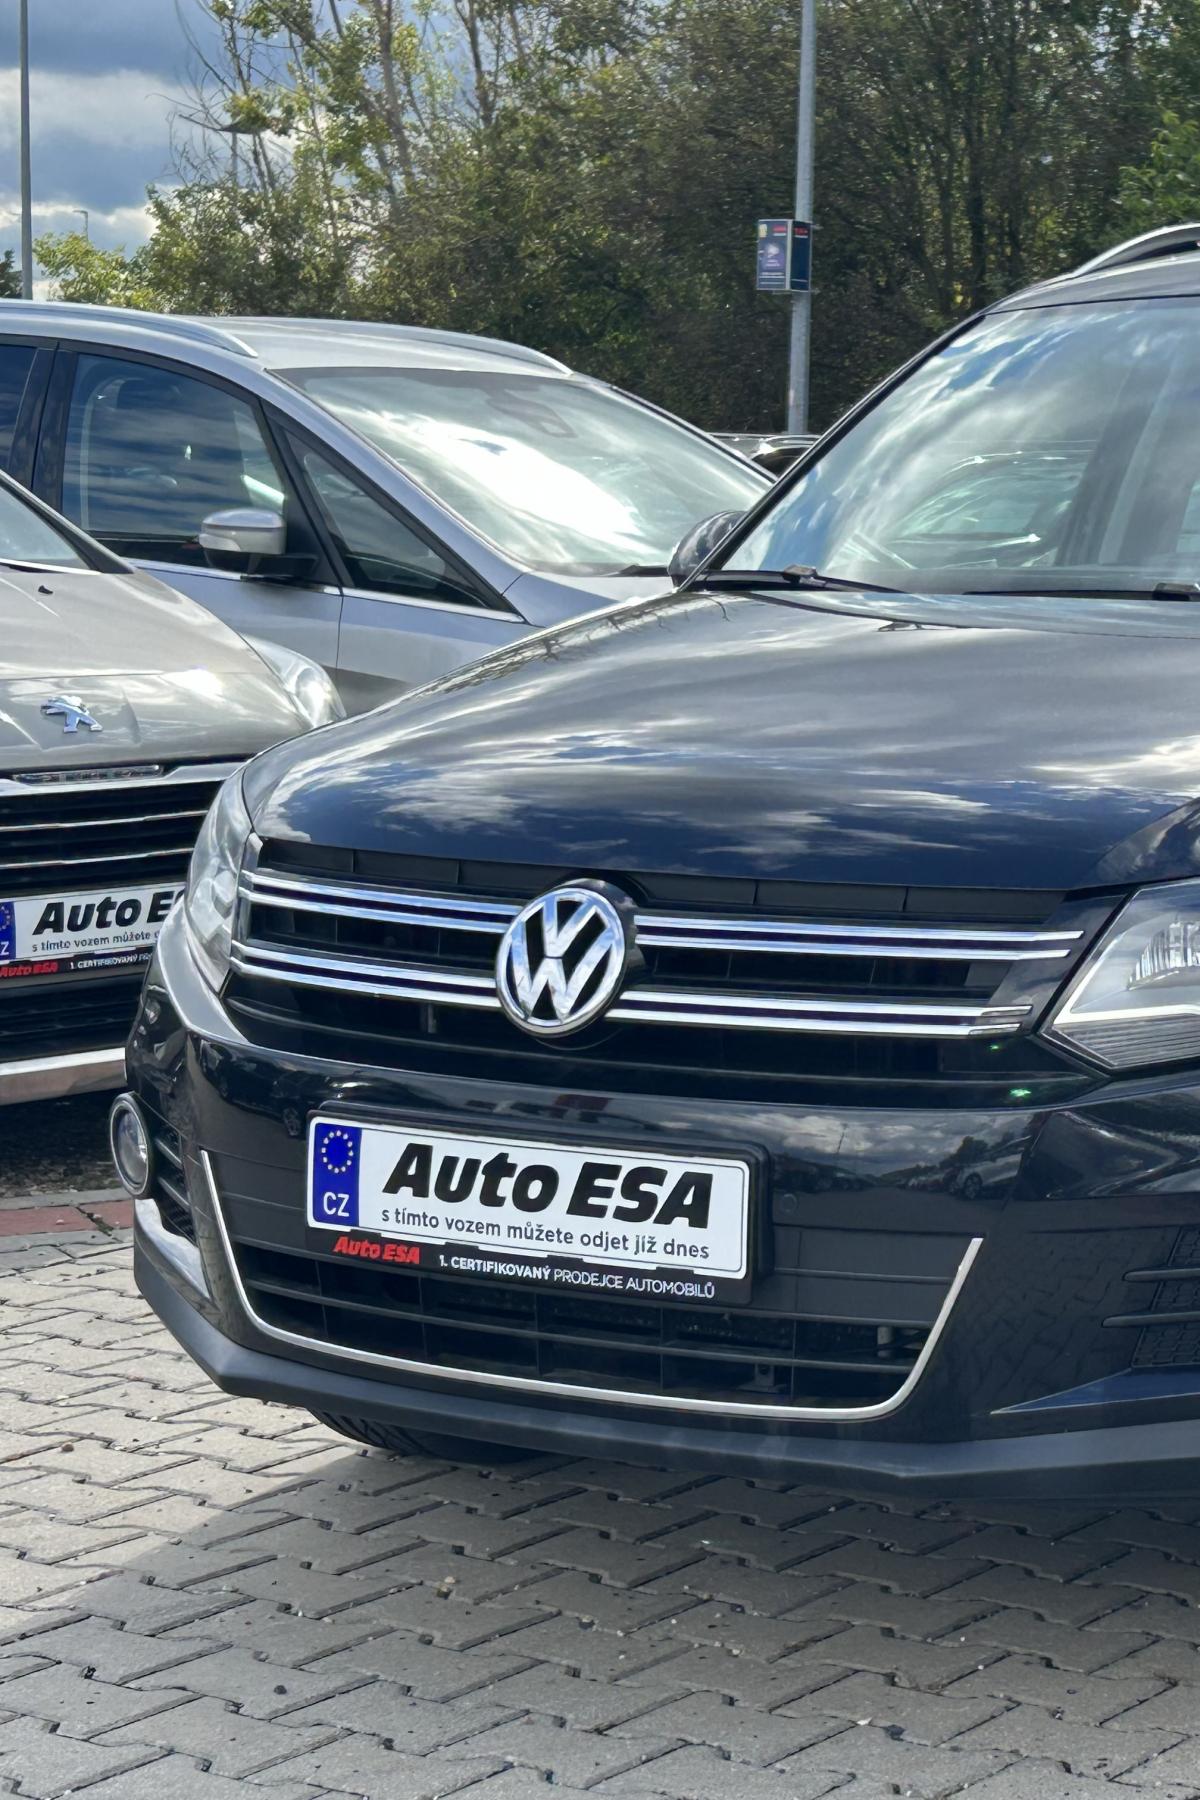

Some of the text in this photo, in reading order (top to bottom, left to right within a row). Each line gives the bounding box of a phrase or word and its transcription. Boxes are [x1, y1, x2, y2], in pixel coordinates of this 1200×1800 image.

[32, 896, 142, 936] Auto
[32, 944, 38, 954] s
[75, 936, 110, 947] vozem
[323, 1192, 350, 1217] CZ
[382, 1143, 713, 1229] Auto ESA
[333, 1236, 420, 1264] Auto ESA
[382, 1209, 390, 1222] s
[394, 1207, 439, 1228] tímto
[445, 1216, 500, 1236] vozem
[507, 1221, 573, 1244] můžete
[580, 1230, 629, 1251] odjet
[664, 1239, 709, 1259] dnes
[439, 1254, 715, 1299] 1. CERTIFIKOVANÝ PRODEJCE AUTOMOBILŮ
